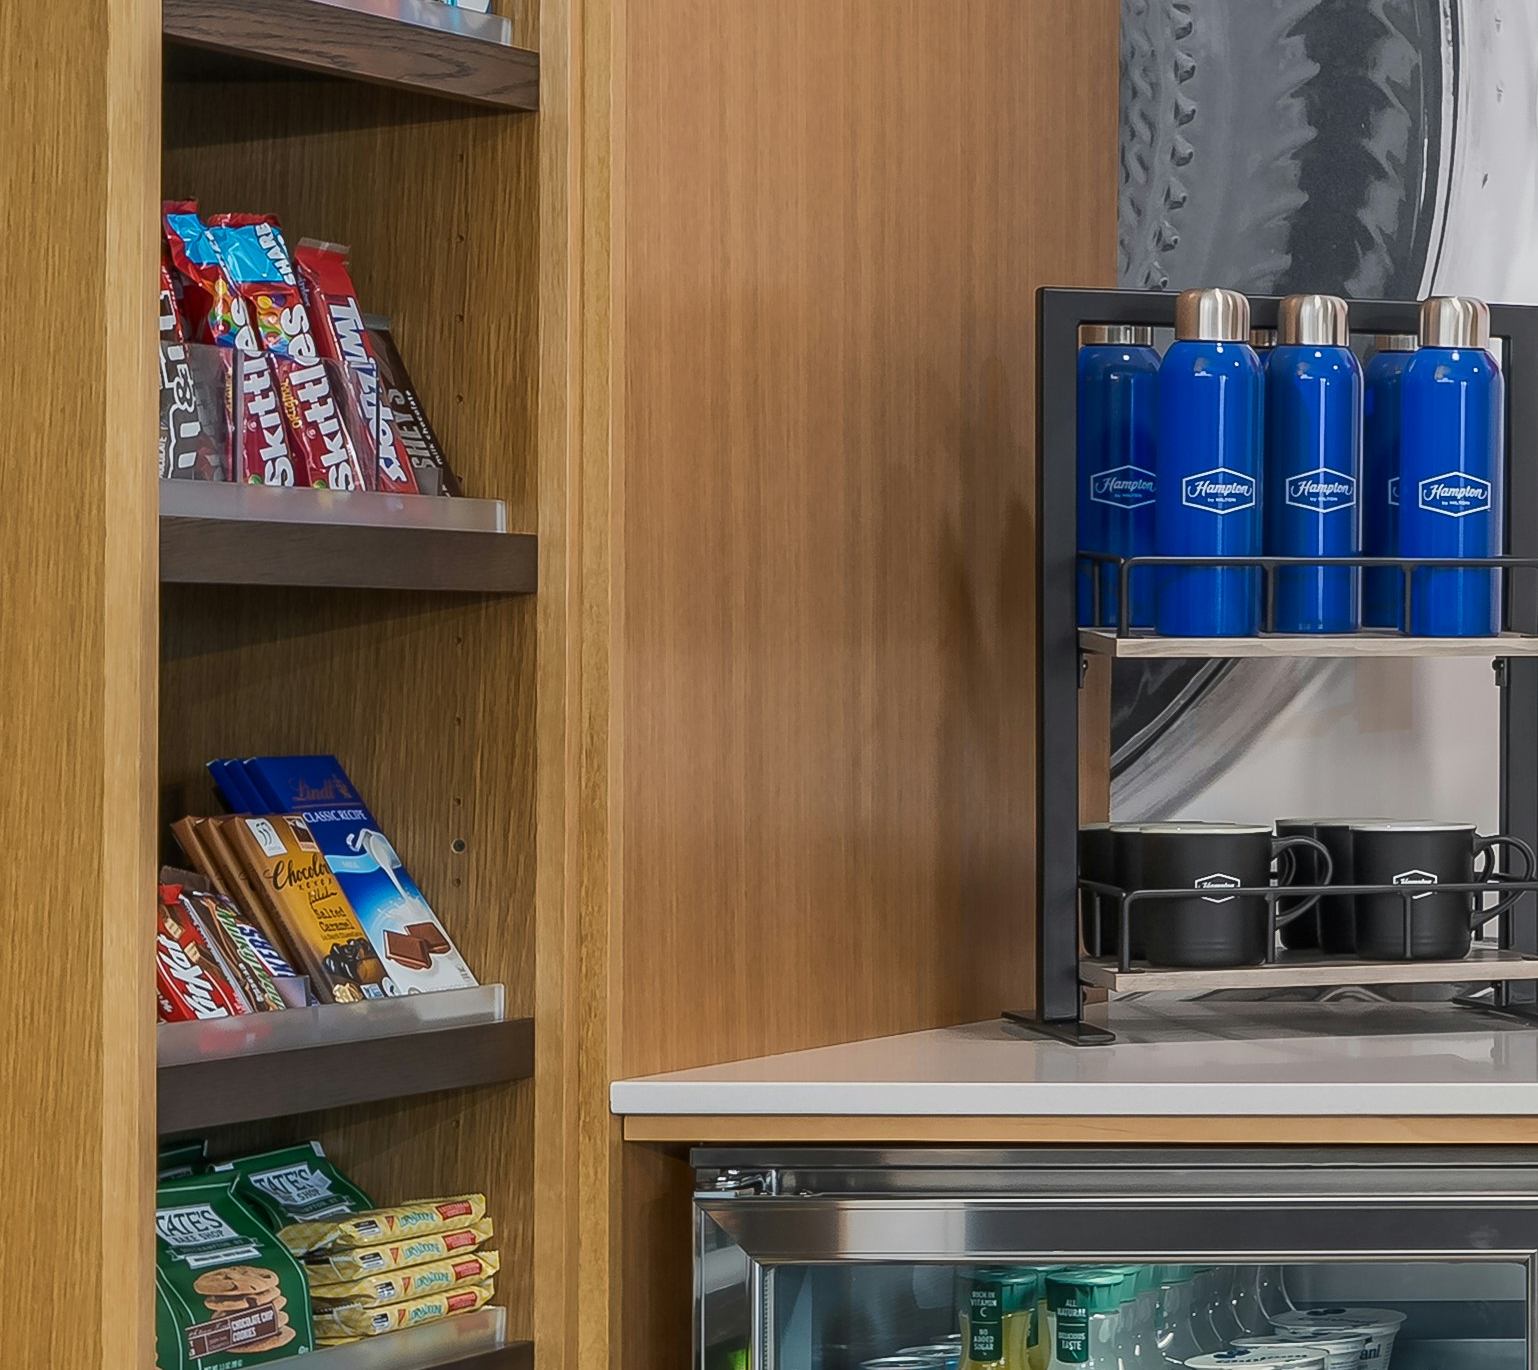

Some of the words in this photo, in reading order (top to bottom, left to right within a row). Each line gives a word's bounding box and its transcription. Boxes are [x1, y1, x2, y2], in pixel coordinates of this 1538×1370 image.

[1096, 477, 1156, 493] Hampton
[1188, 476, 1252, 496] Hampton
[302, 810, 339, 822] CLASSIC
[341, 809, 367, 821] RECIPE
[252, 1167, 311, 1197] TATE'S
